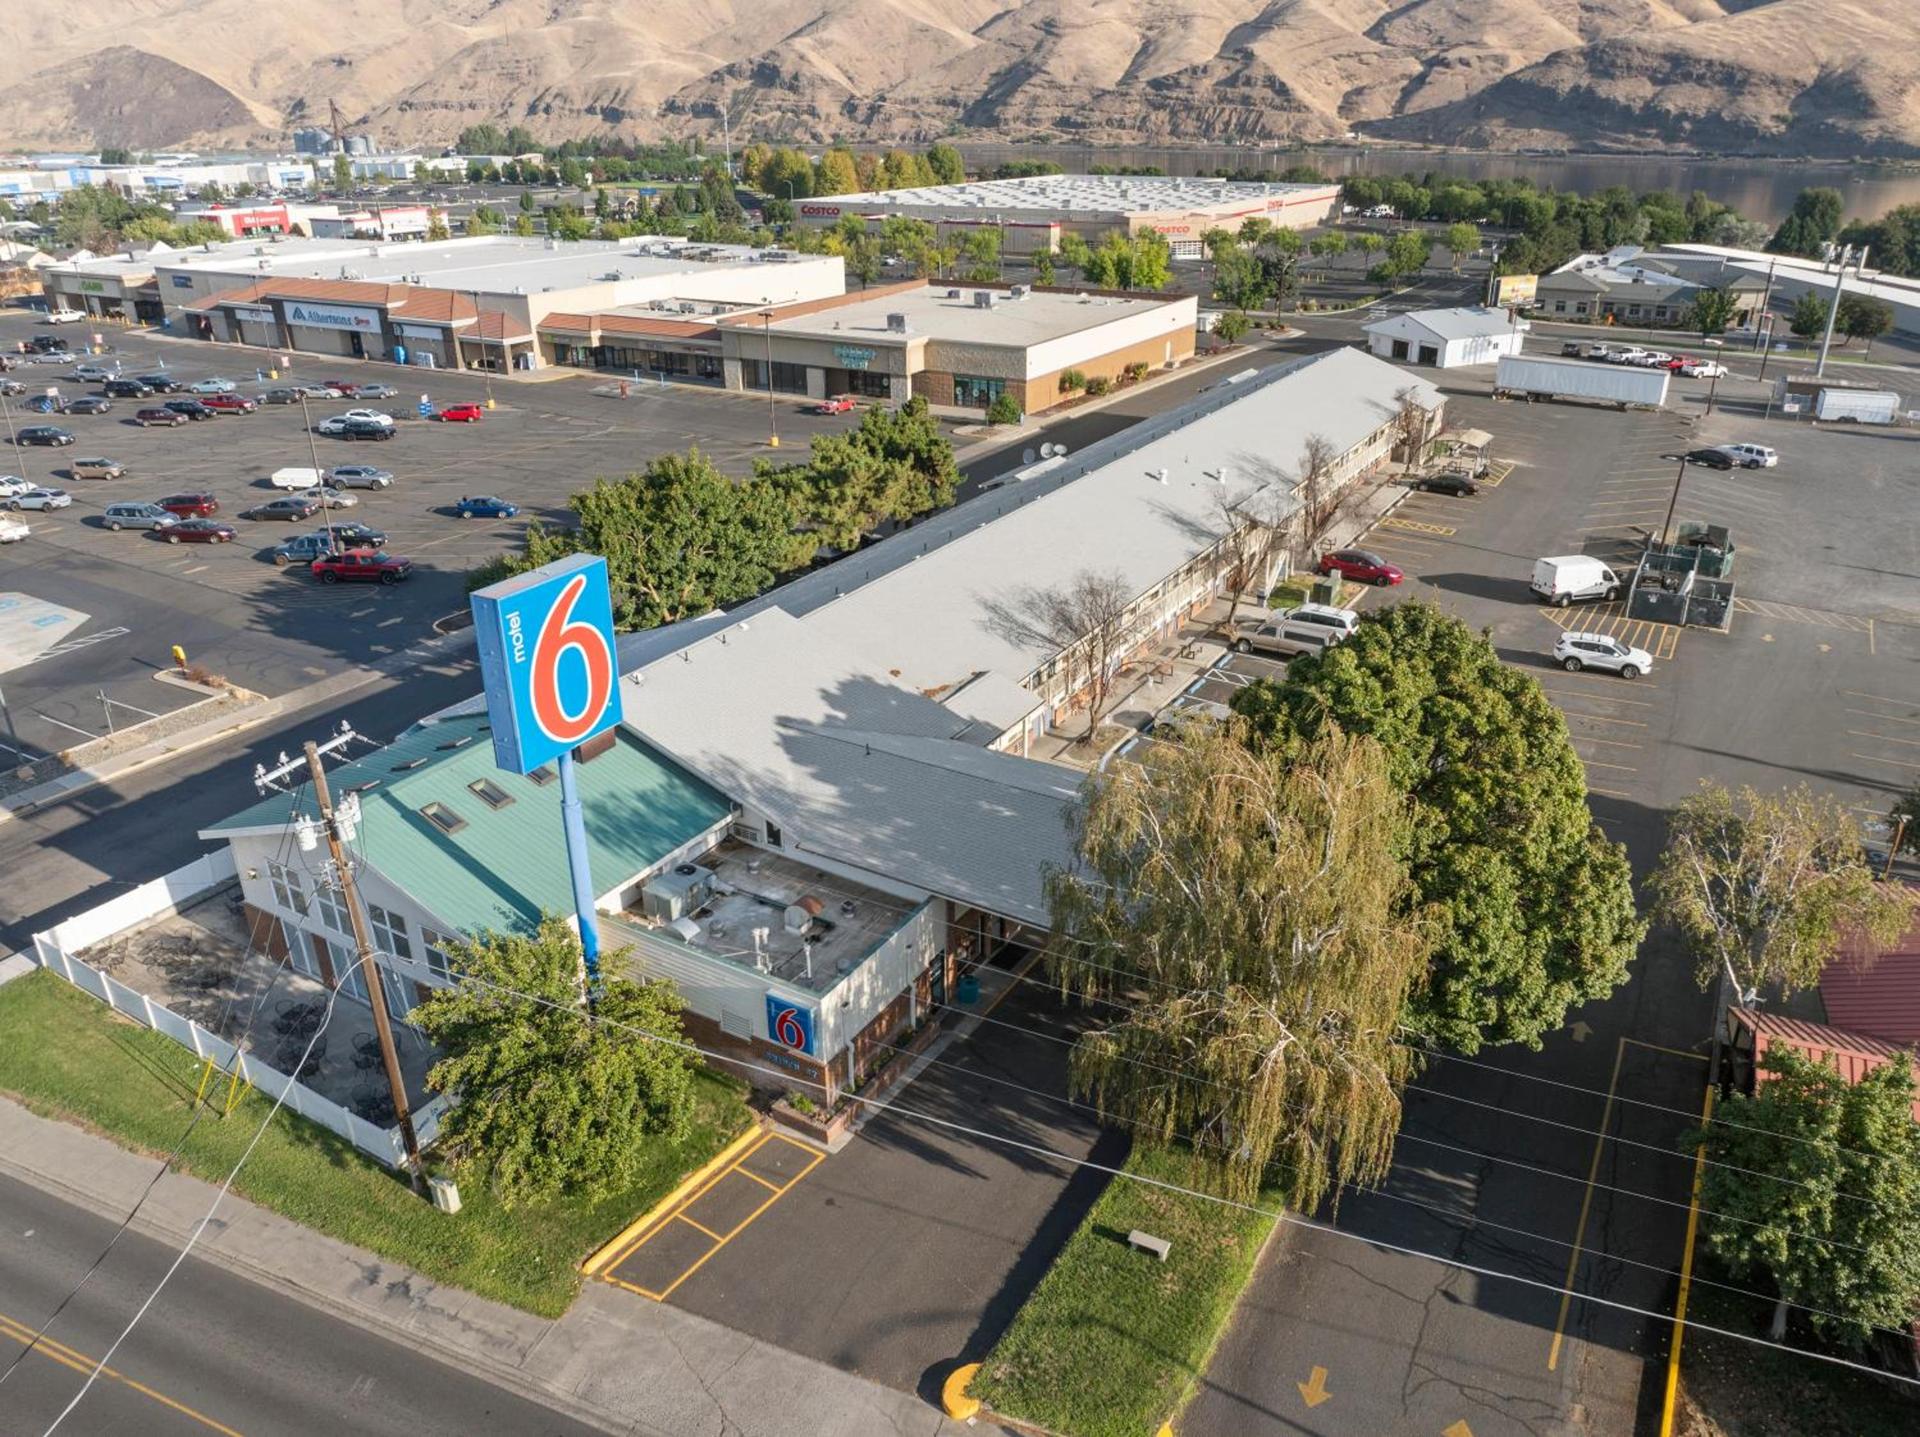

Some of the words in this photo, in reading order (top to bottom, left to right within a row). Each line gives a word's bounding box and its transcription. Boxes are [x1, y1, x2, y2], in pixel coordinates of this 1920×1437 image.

[801, 204, 840, 216] COSTCO
[505, 611, 526, 663] motel
[530, 574, 612, 743] 6
[776, 1008, 805, 1050] 6
